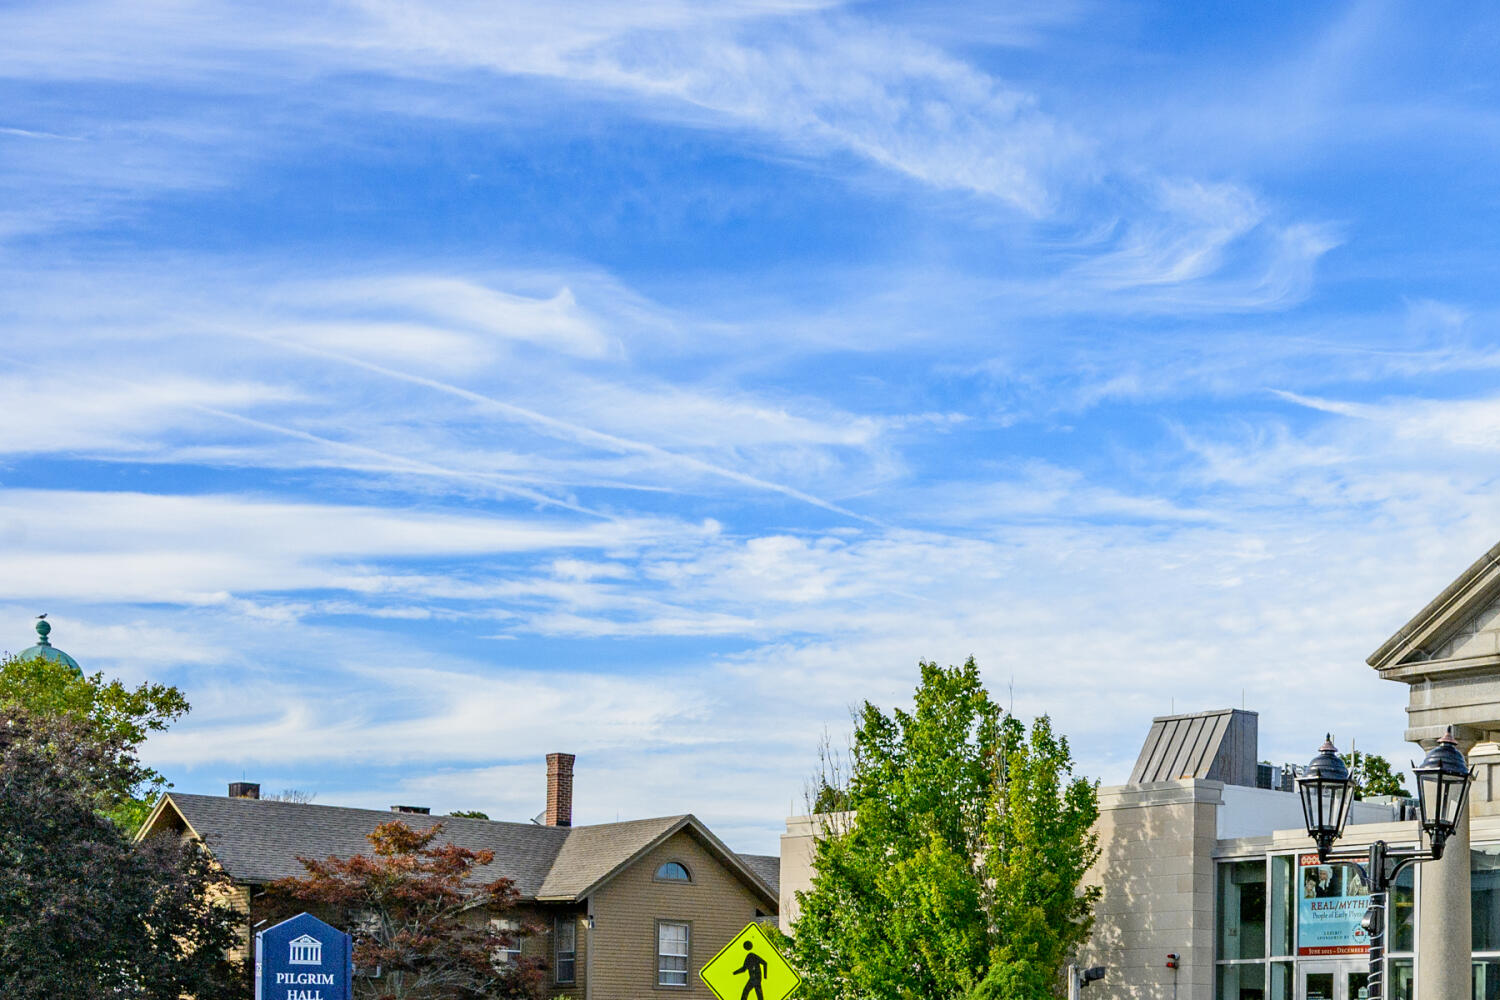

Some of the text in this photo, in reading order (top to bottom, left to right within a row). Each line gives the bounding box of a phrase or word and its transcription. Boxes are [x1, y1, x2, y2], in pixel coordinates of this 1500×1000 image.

[1311, 899, 1369, 911] REAL/MYTHI
[276, 972, 335, 985] PILGRIM
[287, 990, 324, 1000] HALL
